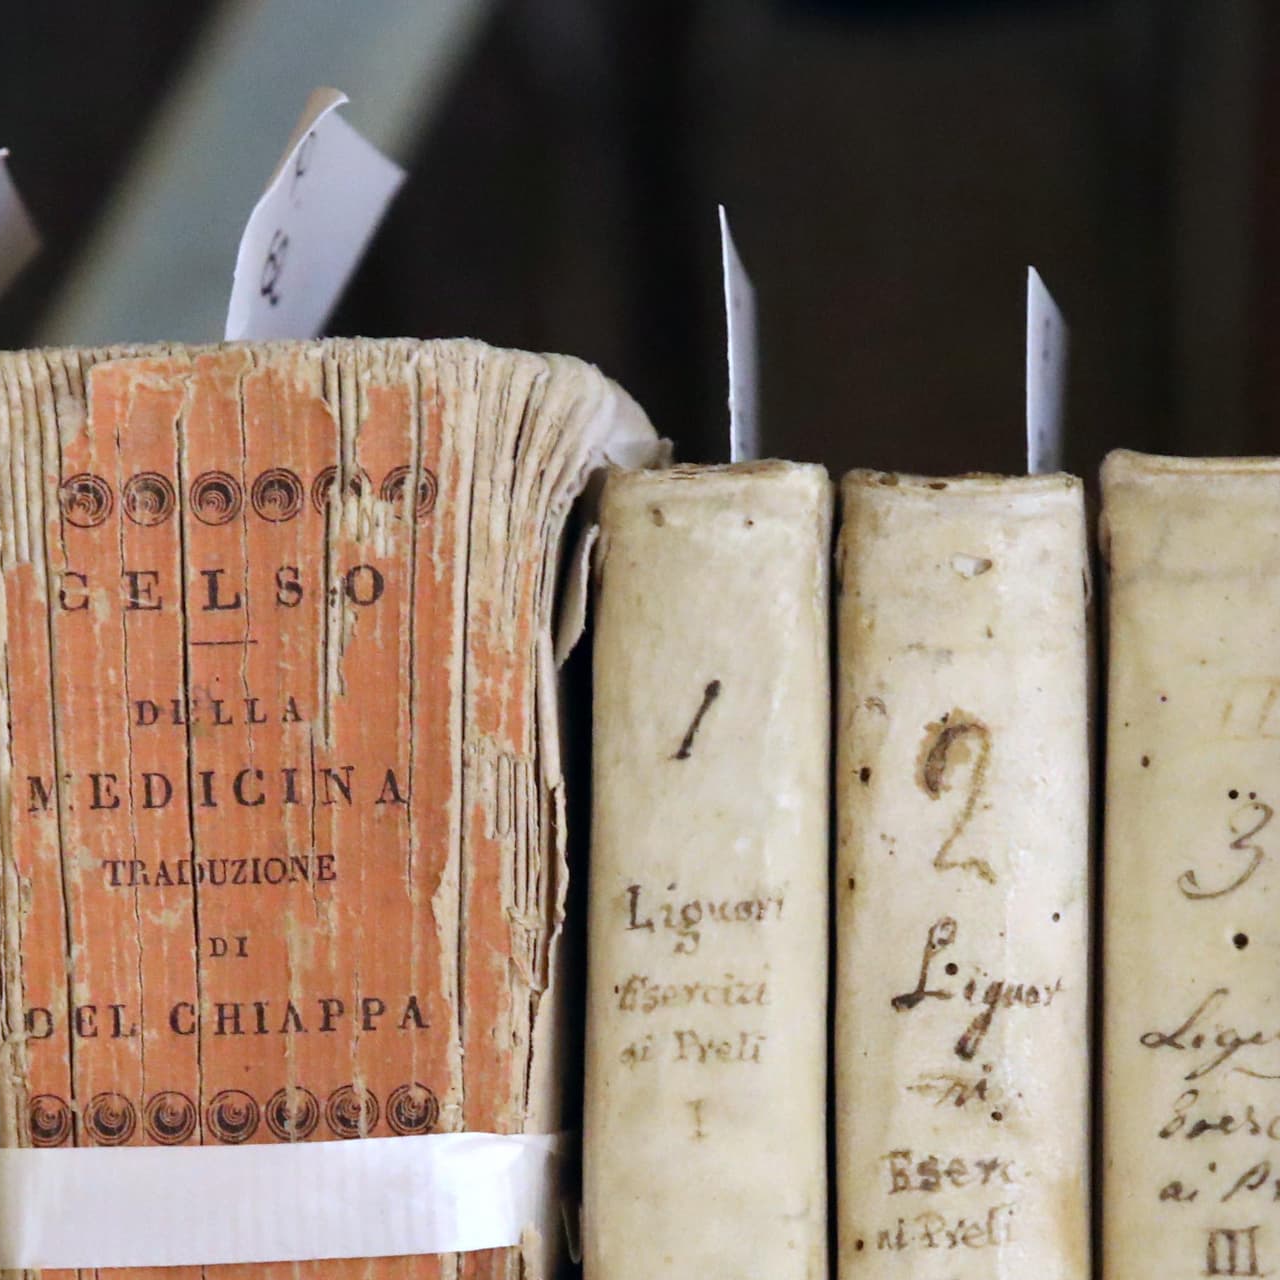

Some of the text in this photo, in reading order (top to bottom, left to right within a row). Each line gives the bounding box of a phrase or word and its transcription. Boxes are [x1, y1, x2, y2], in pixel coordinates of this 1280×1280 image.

[58, 563, 385, 612] CELSO
[26, 765, 410, 813] MEDICINA
[920, 708, 997, 886] 2
[101, 854, 338, 888] TRADUZIONE
[1177, 800, 1275, 901] 3
[208, 935, 250, 958] DI
[168, 995, 431, 1036] CHIAPPA
[1200, 1224, 1276, 1279] III
